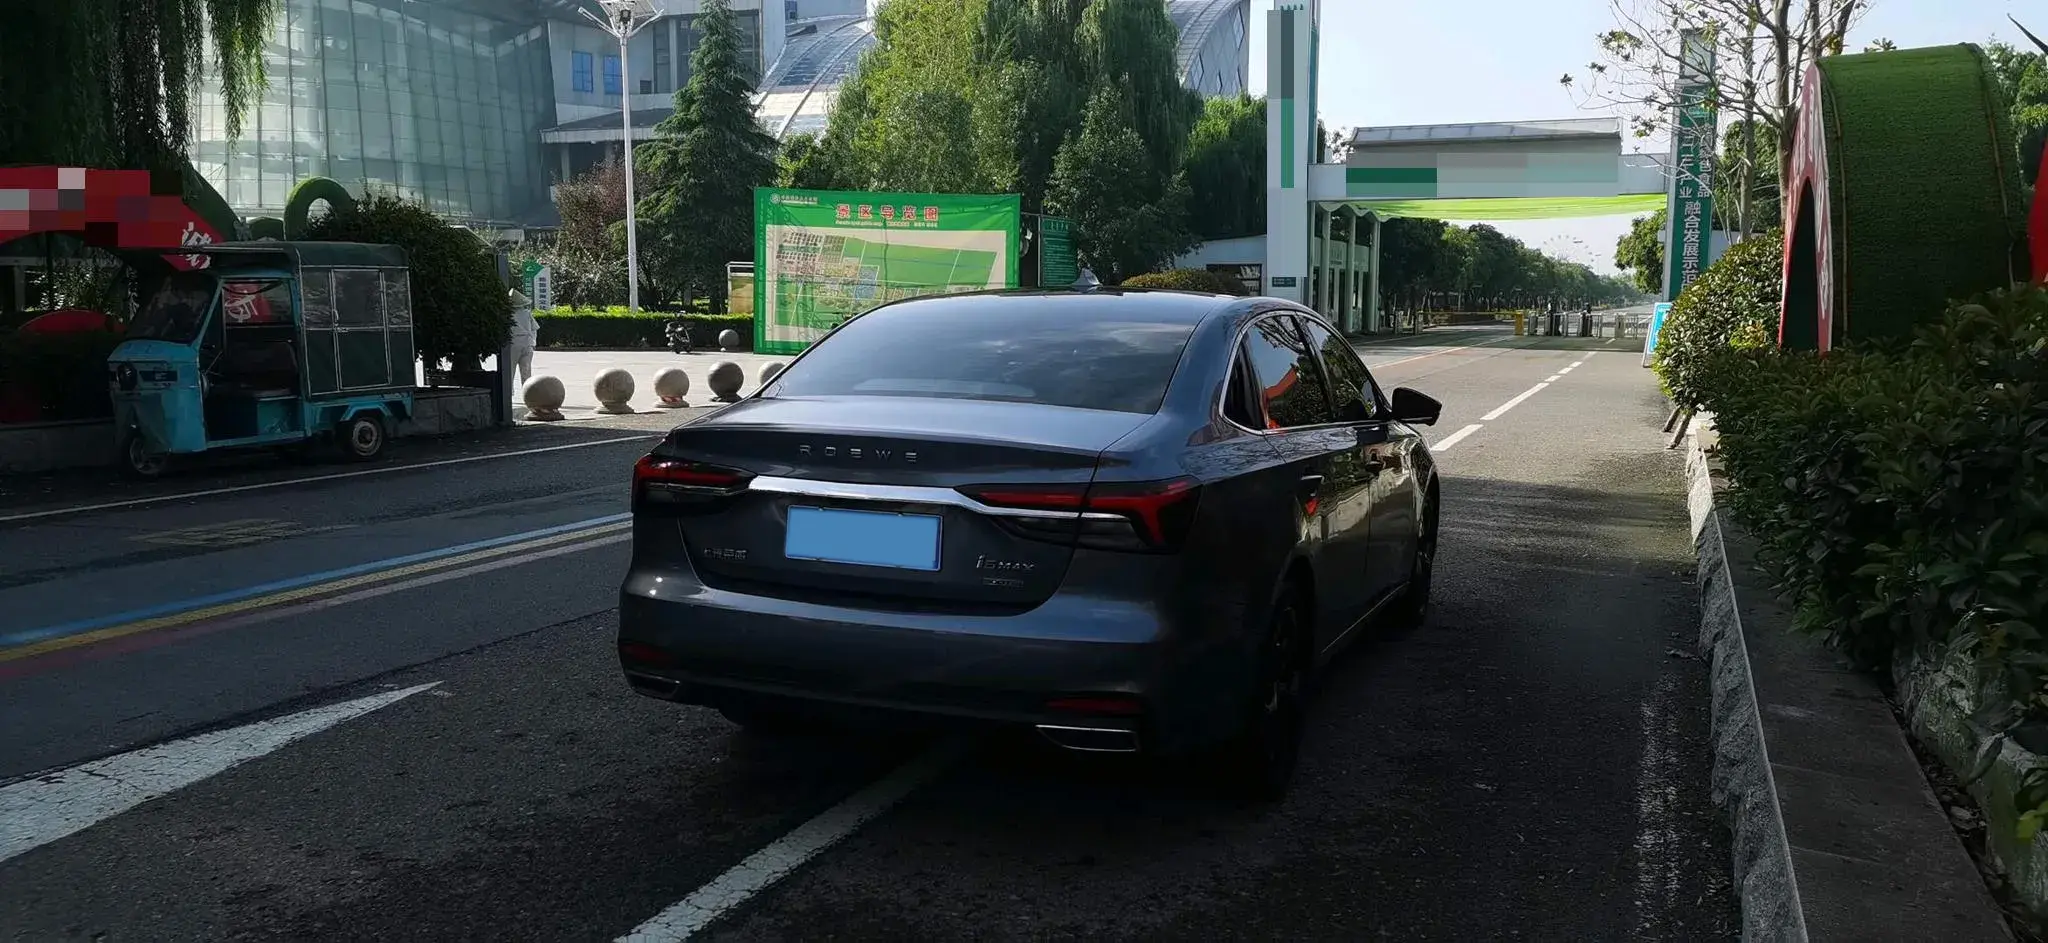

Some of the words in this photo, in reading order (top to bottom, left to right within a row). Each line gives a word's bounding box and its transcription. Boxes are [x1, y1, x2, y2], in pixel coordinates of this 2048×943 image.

[836, 204, 939, 221] 景区导览图
[1681, 201, 1701, 292] 融合发展示范
[799, 444, 918, 463] ROEWE
